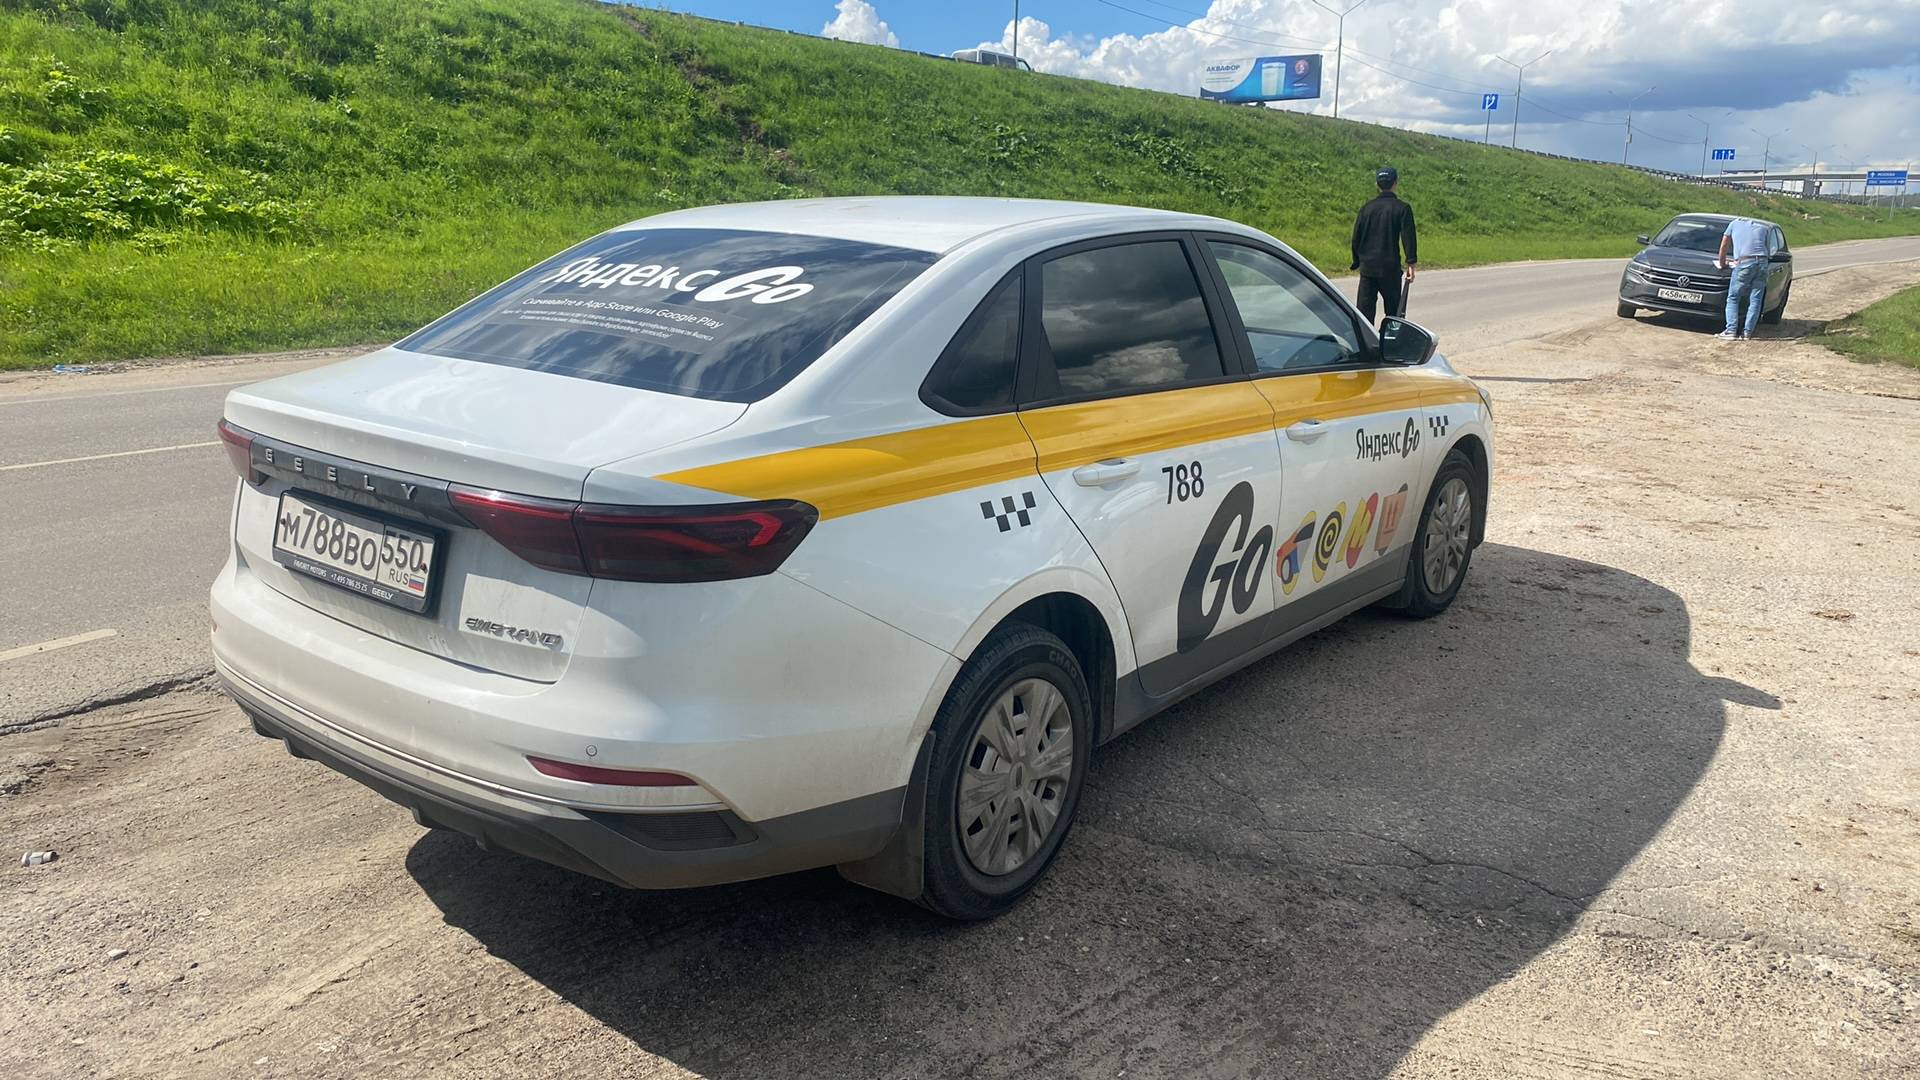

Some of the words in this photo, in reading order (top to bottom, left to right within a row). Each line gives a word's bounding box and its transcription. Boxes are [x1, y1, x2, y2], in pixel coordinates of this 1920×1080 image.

[1206, 64, 1241, 72] АКВАФОР
[540, 256, 721, 292] Яндекс
[694, 265, 814, 304] Go
[582, 300, 605, 309] App
[605, 301, 634, 312] Store
[633, 307, 656, 315] или
[656, 309, 697, 322] Google
[696, 316, 724, 330] Play
[1356, 428, 1401, 462] Яндекс
[1402, 417, 1420, 459] Go
[265, 448, 417, 500] GEELY
[1162, 461, 1204, 504] 788
[382, 530, 424, 572] 550
[1177, 481, 1273, 655] Go
[361, 583, 368, 592] 25
[371, 587, 394, 600] GEELY
[389, 568, 409, 585] RUS
